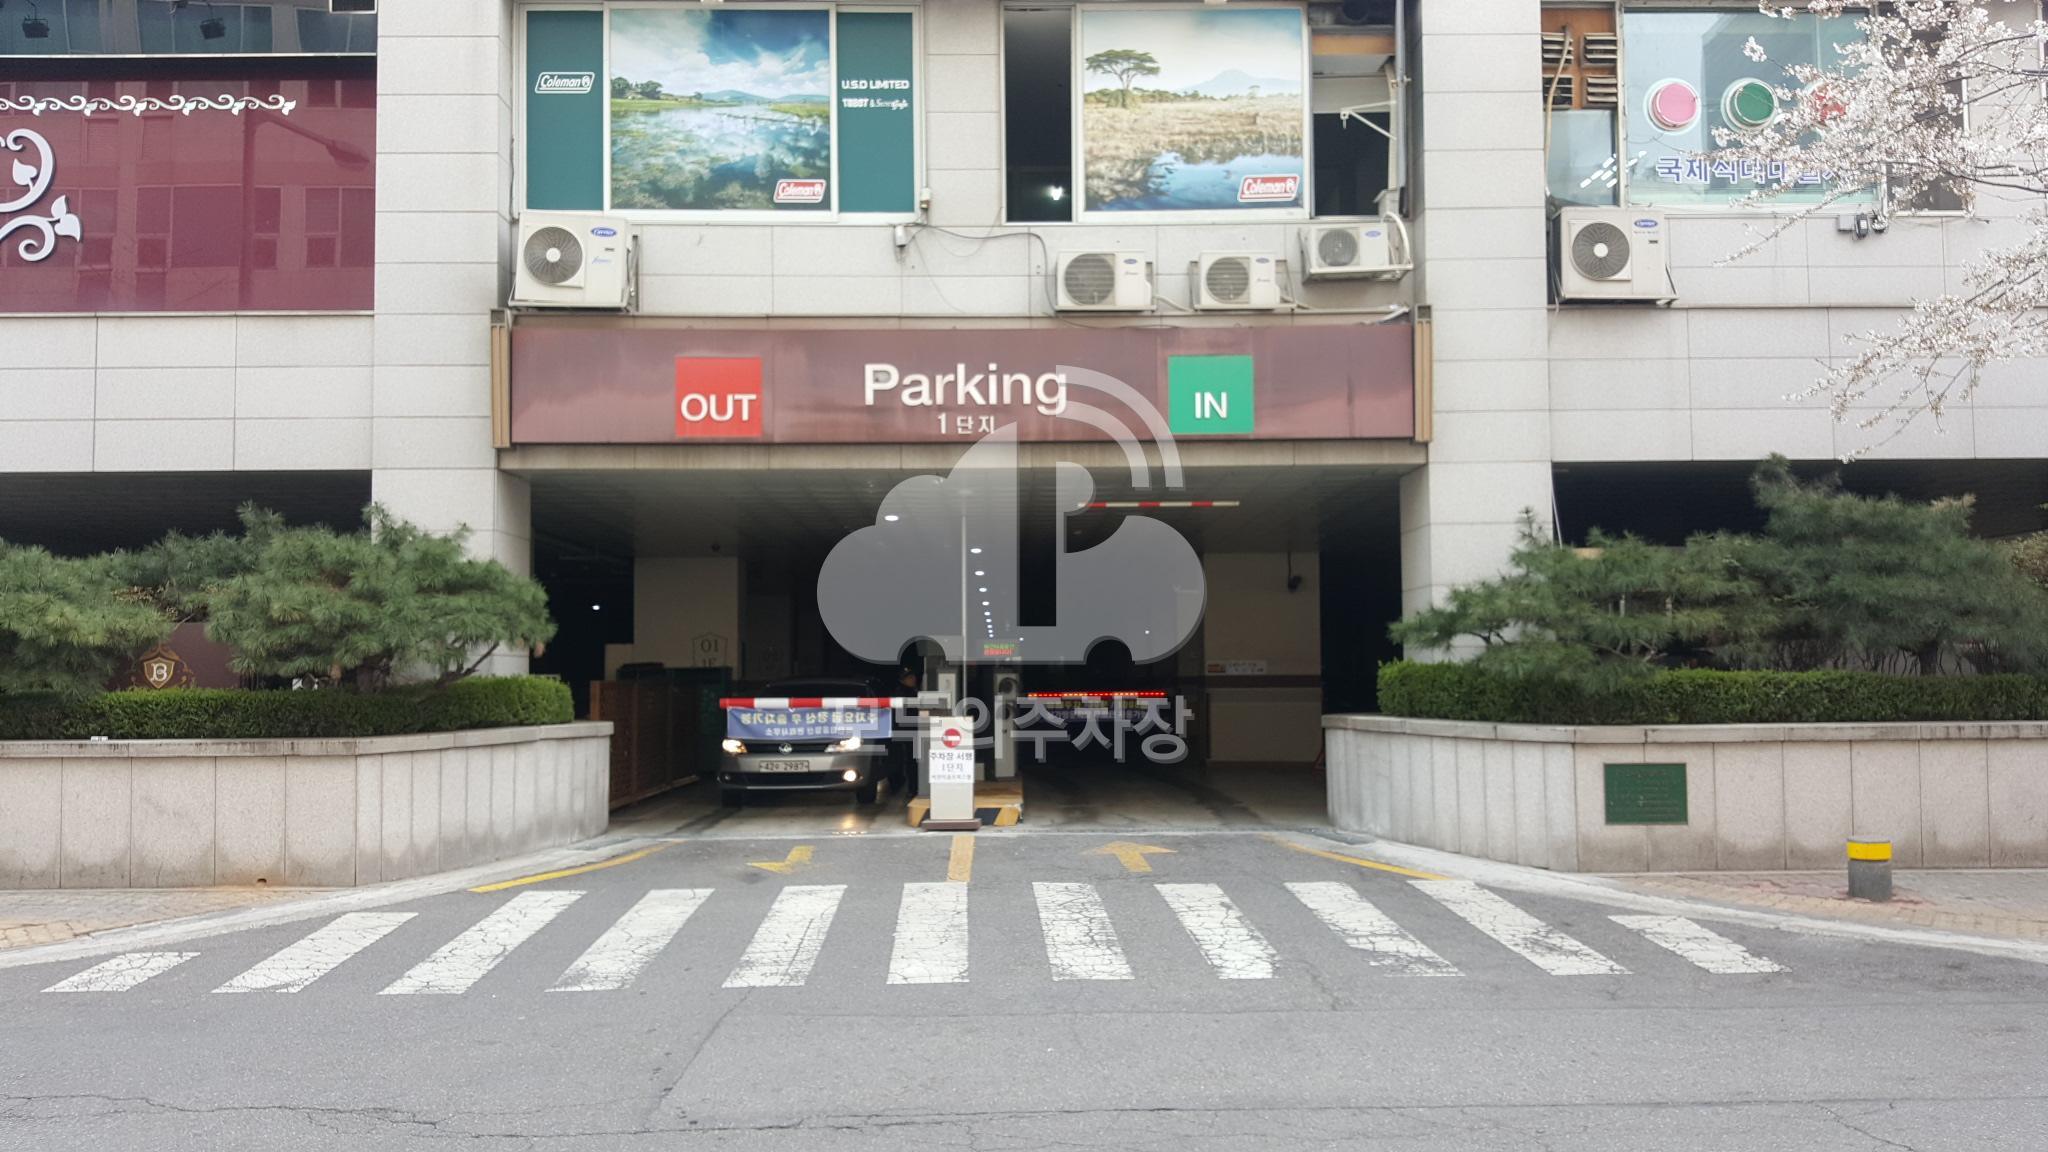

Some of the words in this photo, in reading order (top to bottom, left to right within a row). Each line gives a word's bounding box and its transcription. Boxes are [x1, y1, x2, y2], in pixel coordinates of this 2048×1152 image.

[869, 80, 910, 89] LIMITED
[864, 363, 1067, 416] Parking
[681, 393, 757, 421] OUT
[1195, 392, 1227, 418] IN
